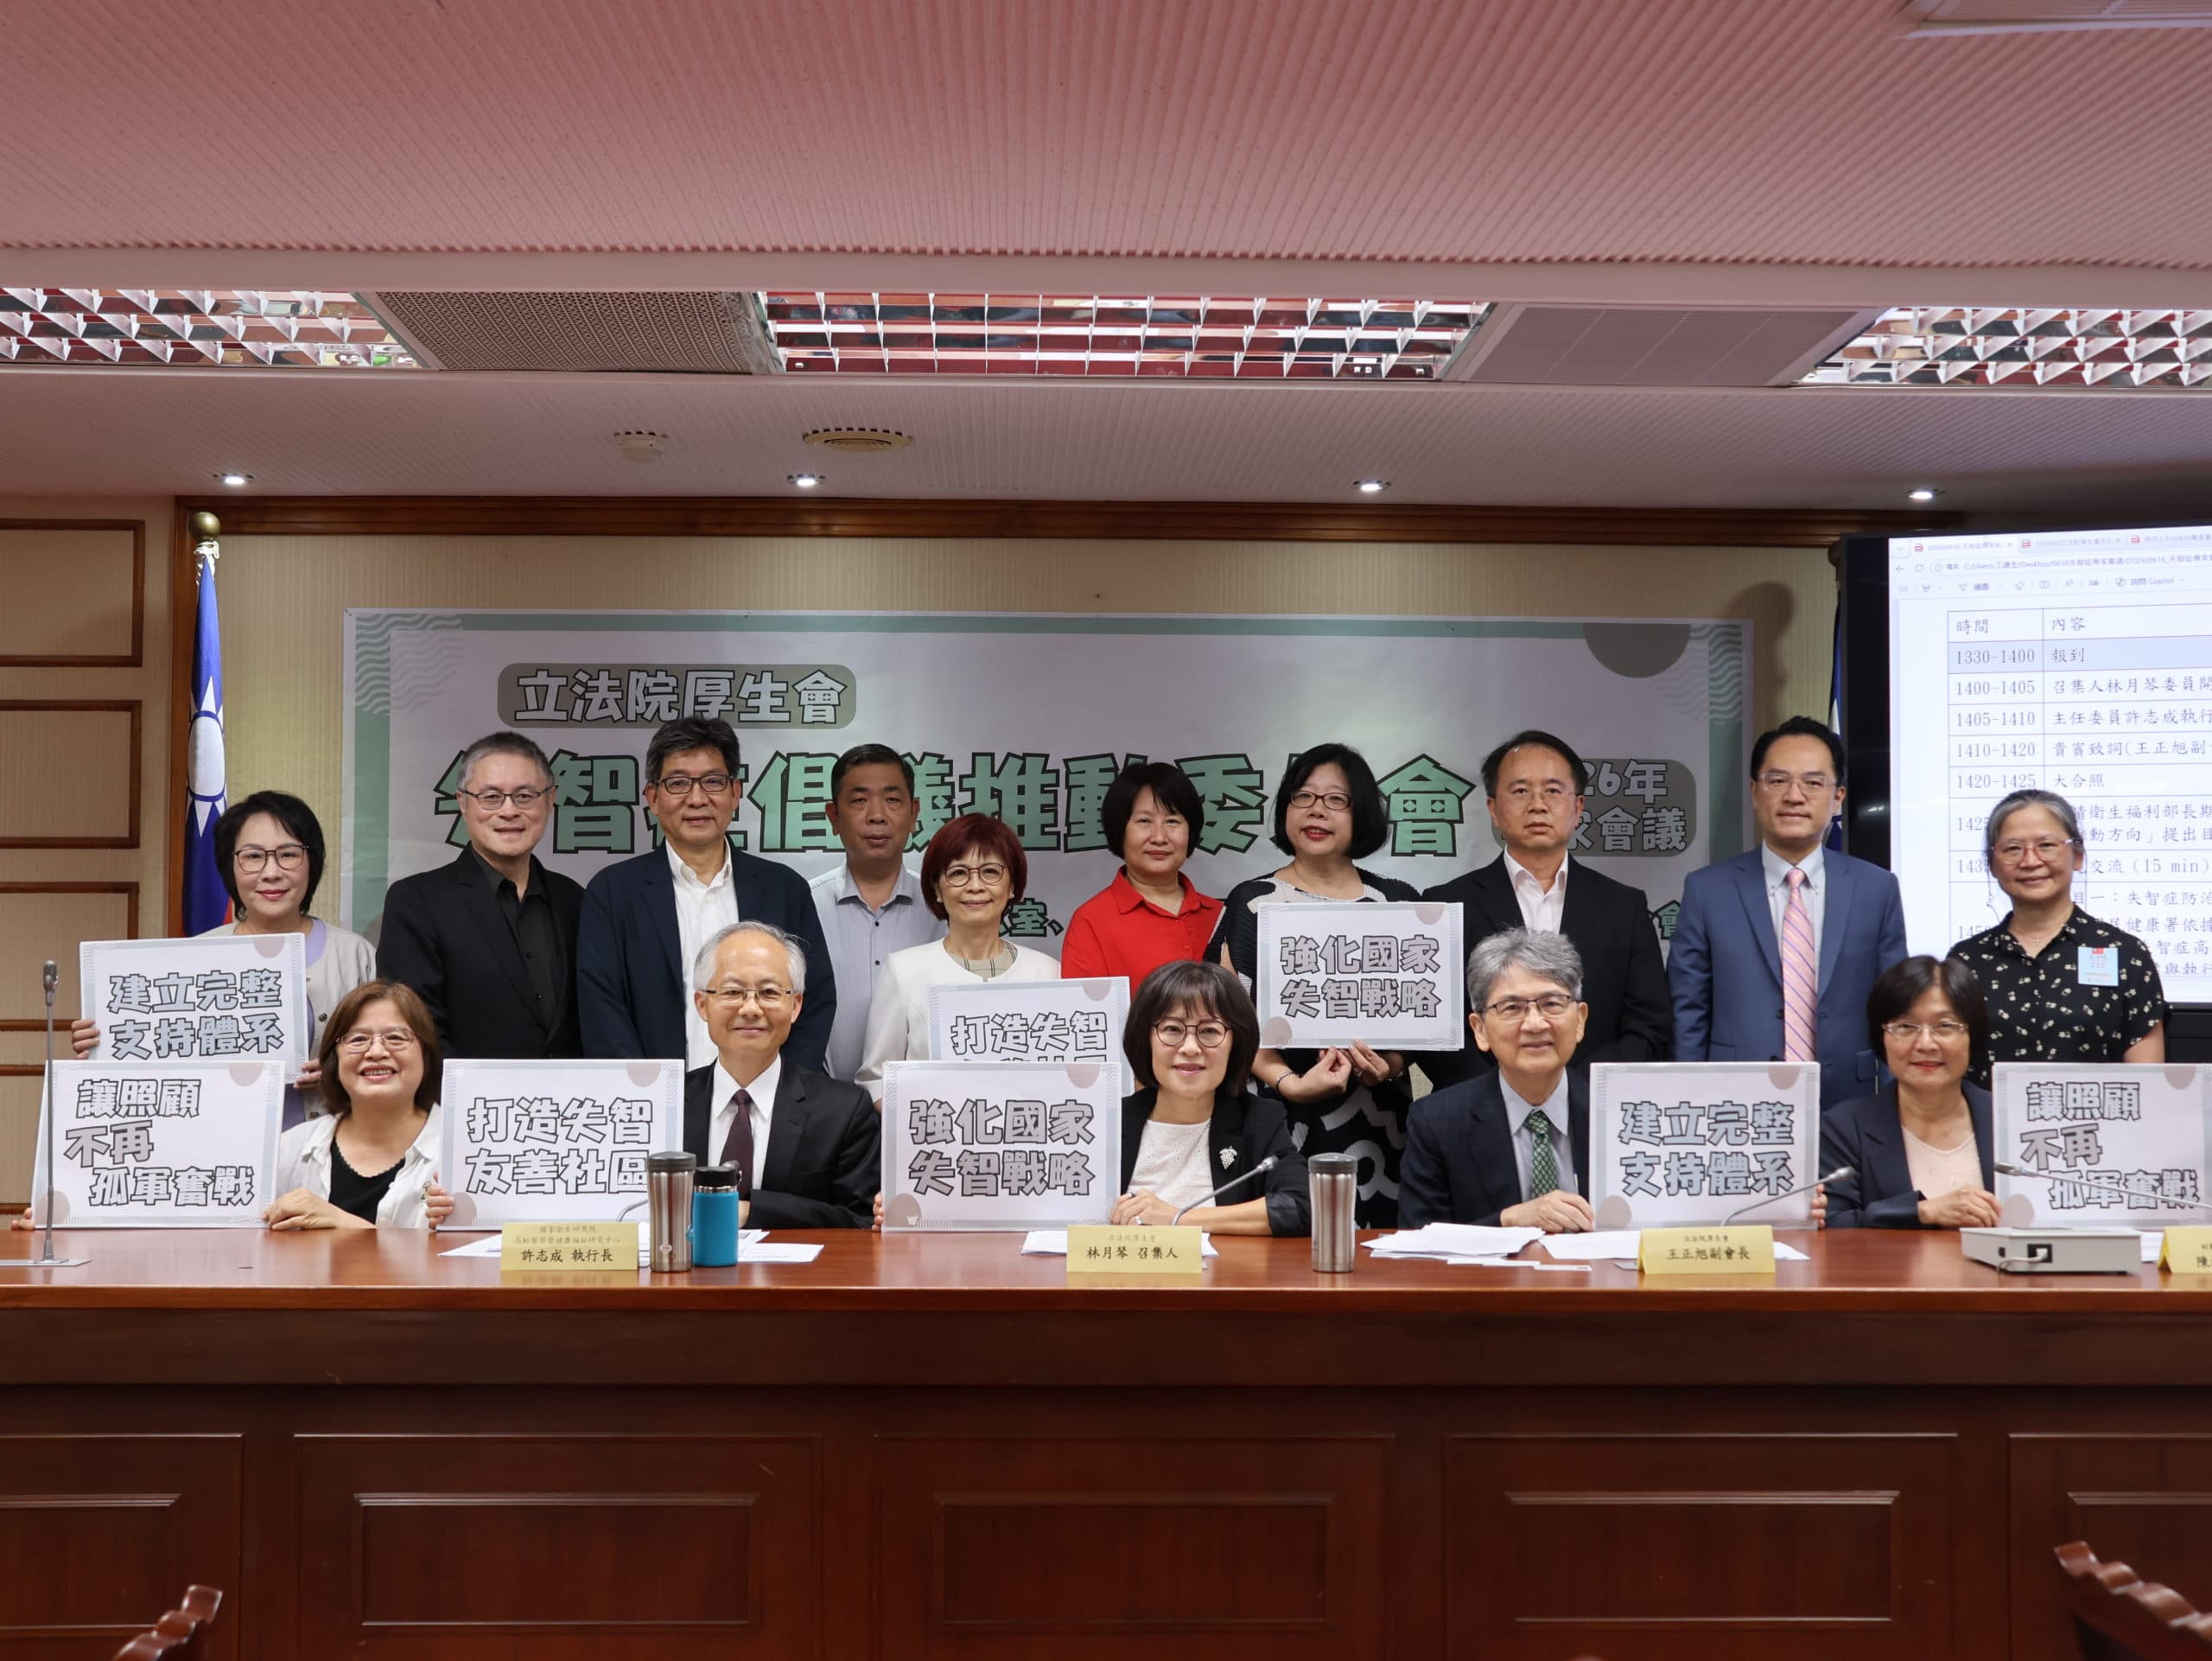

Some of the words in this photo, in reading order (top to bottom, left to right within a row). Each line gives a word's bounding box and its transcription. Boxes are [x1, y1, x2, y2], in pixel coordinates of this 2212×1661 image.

[1956, 619, 1989, 635] 時間
[2051, 617, 2086, 633] 內容
[1956, 648, 2035, 665] 1330-1400
[2051, 646, 2085, 663] 報到
[514, 668, 848, 724] 立法院厚生會
[1957, 679, 2036, 696] 1400-1405
[1957, 711, 2036, 727] 1405-1410
[1957, 741, 2036, 758] 1410-1420
[2053, 740, 2212, 758] 貴賓致詞(王正旭副
[1957, 773, 2037, 789] 1420-1425
[2054, 773, 2106, 788] 大合照
[1280, 934, 1440, 975] 強化國家
[107, 968, 282, 1015] 建立完整
[1281, 977, 1442, 1018] 失智戰略
[109, 1012, 284, 1060] 支持體系
[950, 1010, 1108, 1055] 打造失智
[76, 1079, 201, 1119] 讓照顧
[2026, 1082, 2141, 1122] 讓照顧
[467, 1096, 653, 1144] 打造失智
[909, 1098, 1095, 1145] 強化國家
[1618, 1100, 1795, 1146] 建立完整
[63, 1120, 155, 1168] 不再
[2019, 1123, 2103, 1171] 不再
[89, 1165, 256, 1207] 孤軍奮戰
[465, 1148, 650, 1195] 友善社區
[908, 1149, 1096, 1198] 失智戰略
[1619, 1150, 1795, 1198] 支持體系
[2048, 1168, 2200, 1210] 孤軍奮戰
[520, 1248, 563, 1263] 許志成
[571, 1248, 614, 1263] 執行長
[1086, 1246, 1128, 1260] 林月琴
[1137, 1246, 1179, 1260] 召集人
[1666, 1245, 1752, 1261] 王正旭副會長
